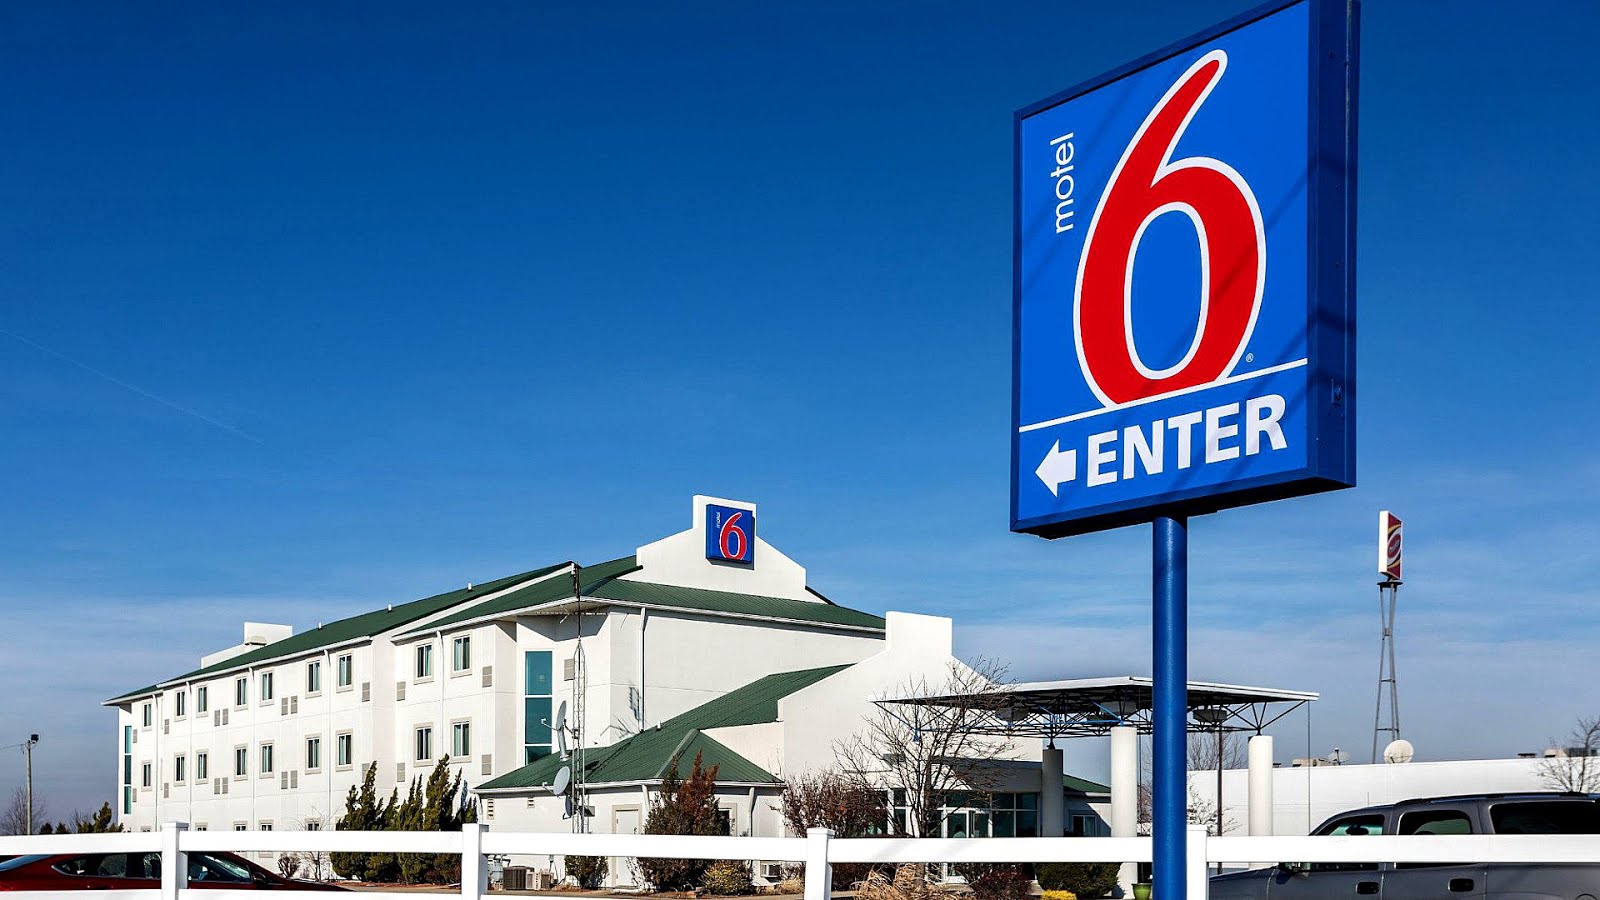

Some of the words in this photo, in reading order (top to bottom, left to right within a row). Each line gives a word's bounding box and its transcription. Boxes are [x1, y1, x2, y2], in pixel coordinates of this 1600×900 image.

[1050, 132, 1075, 234] motel
[1073, 48, 1266, 410] 6
[1086, 393, 1288, 488] ENTER
[719, 511, 747, 560] 6
